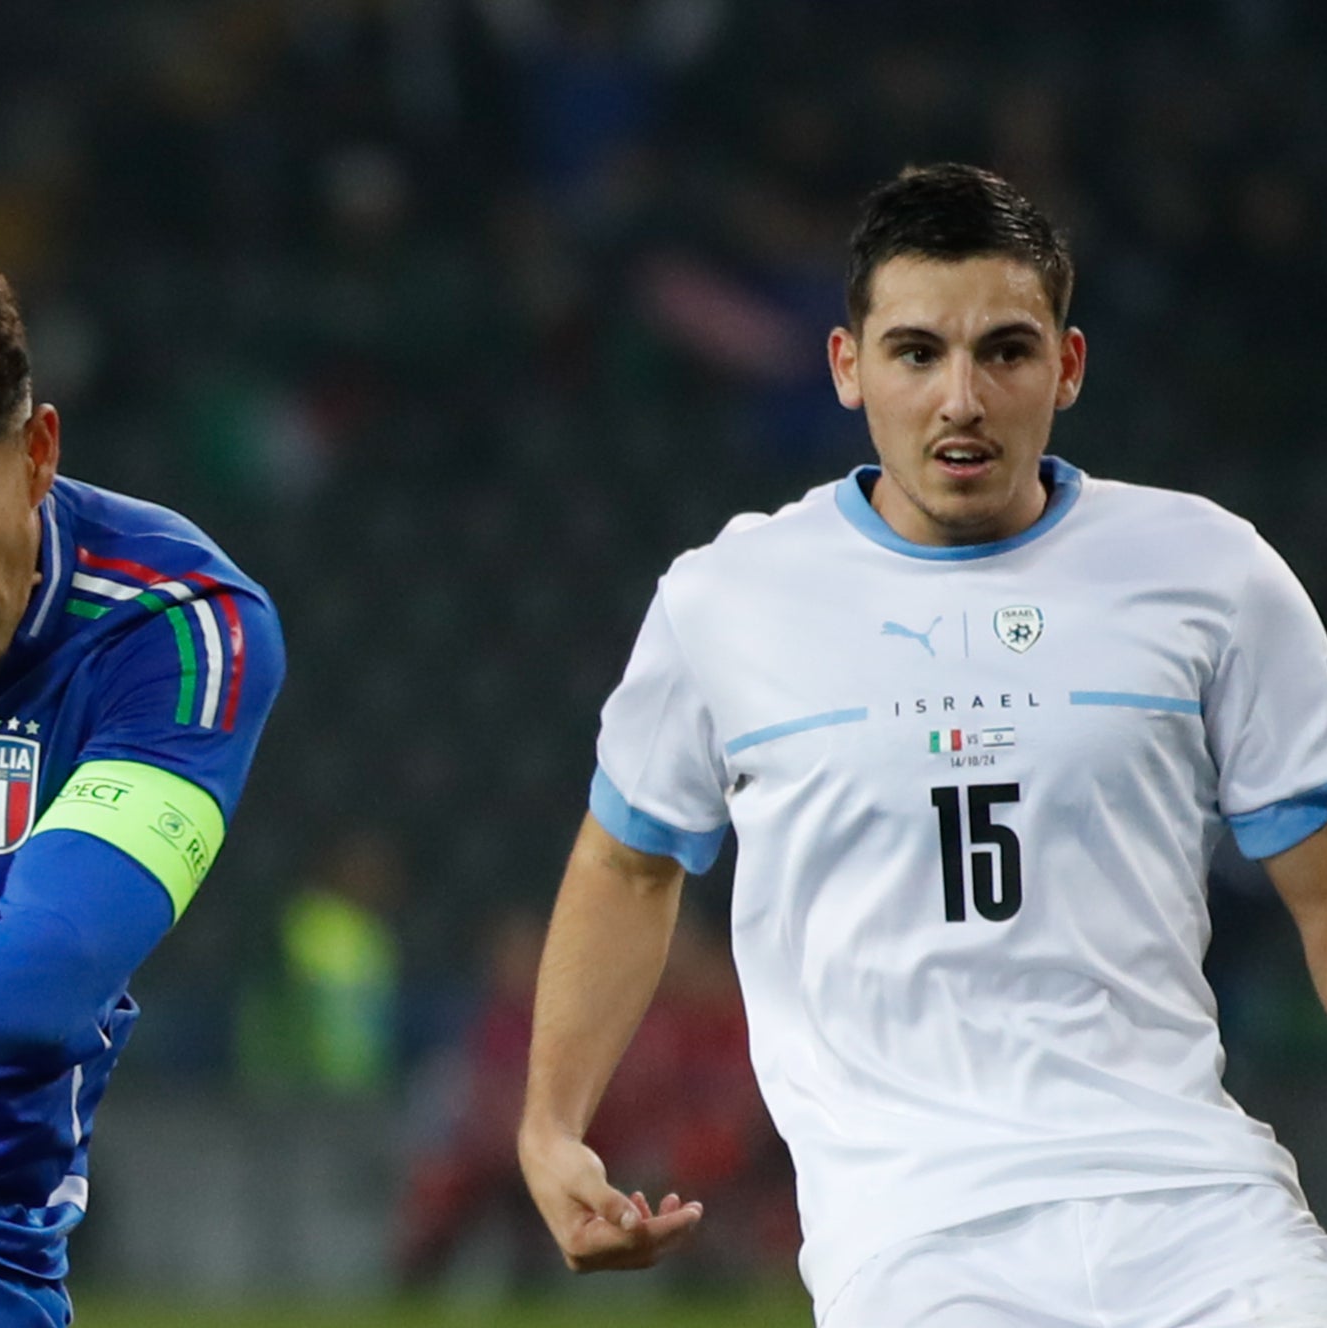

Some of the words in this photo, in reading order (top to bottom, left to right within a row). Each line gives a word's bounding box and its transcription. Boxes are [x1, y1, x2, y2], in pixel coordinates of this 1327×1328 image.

[894, 692, 1040, 717] ISRAEL
[966, 733, 979, 746] VS
[950, 754, 996, 768] 14/10/24
[930, 782, 1023, 923] 15
